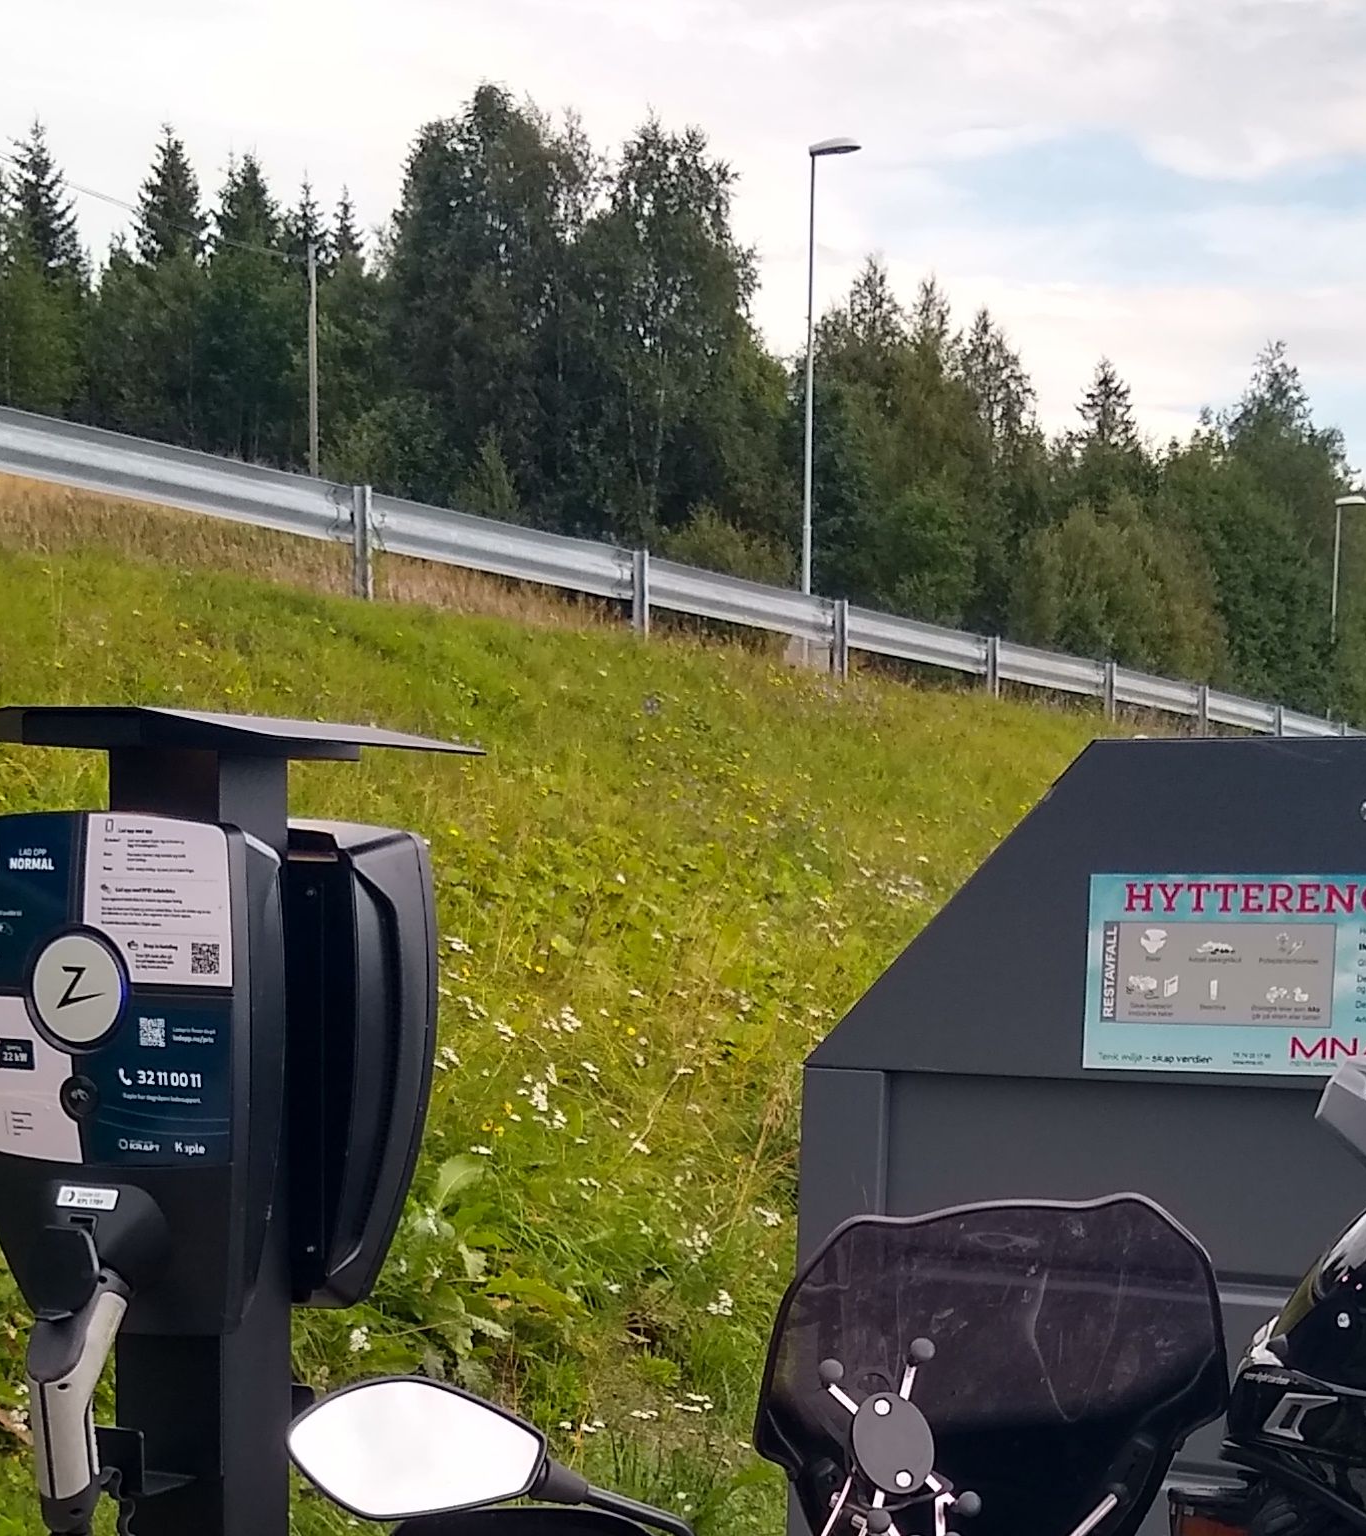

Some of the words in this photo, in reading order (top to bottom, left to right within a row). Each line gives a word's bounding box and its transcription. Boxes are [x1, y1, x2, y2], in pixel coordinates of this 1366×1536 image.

[19, 848, 32, 856] LAD
[33, 848, 48, 857] OPP
[9, 858, 55, 870] NORMAL
[1102, 926, 1118, 1018] RESTAVFALL
[1356, 987, 1366, 995] og
[1151, 1054, 1175, 1065] skap
[1176, 1055, 1213, 1064] verdier
[137, 1070, 155, 1085] 32
[156, 1071, 168, 1086] 11
[170, 1072, 188, 1087] 00
[189, 1073, 202, 1088] 11
